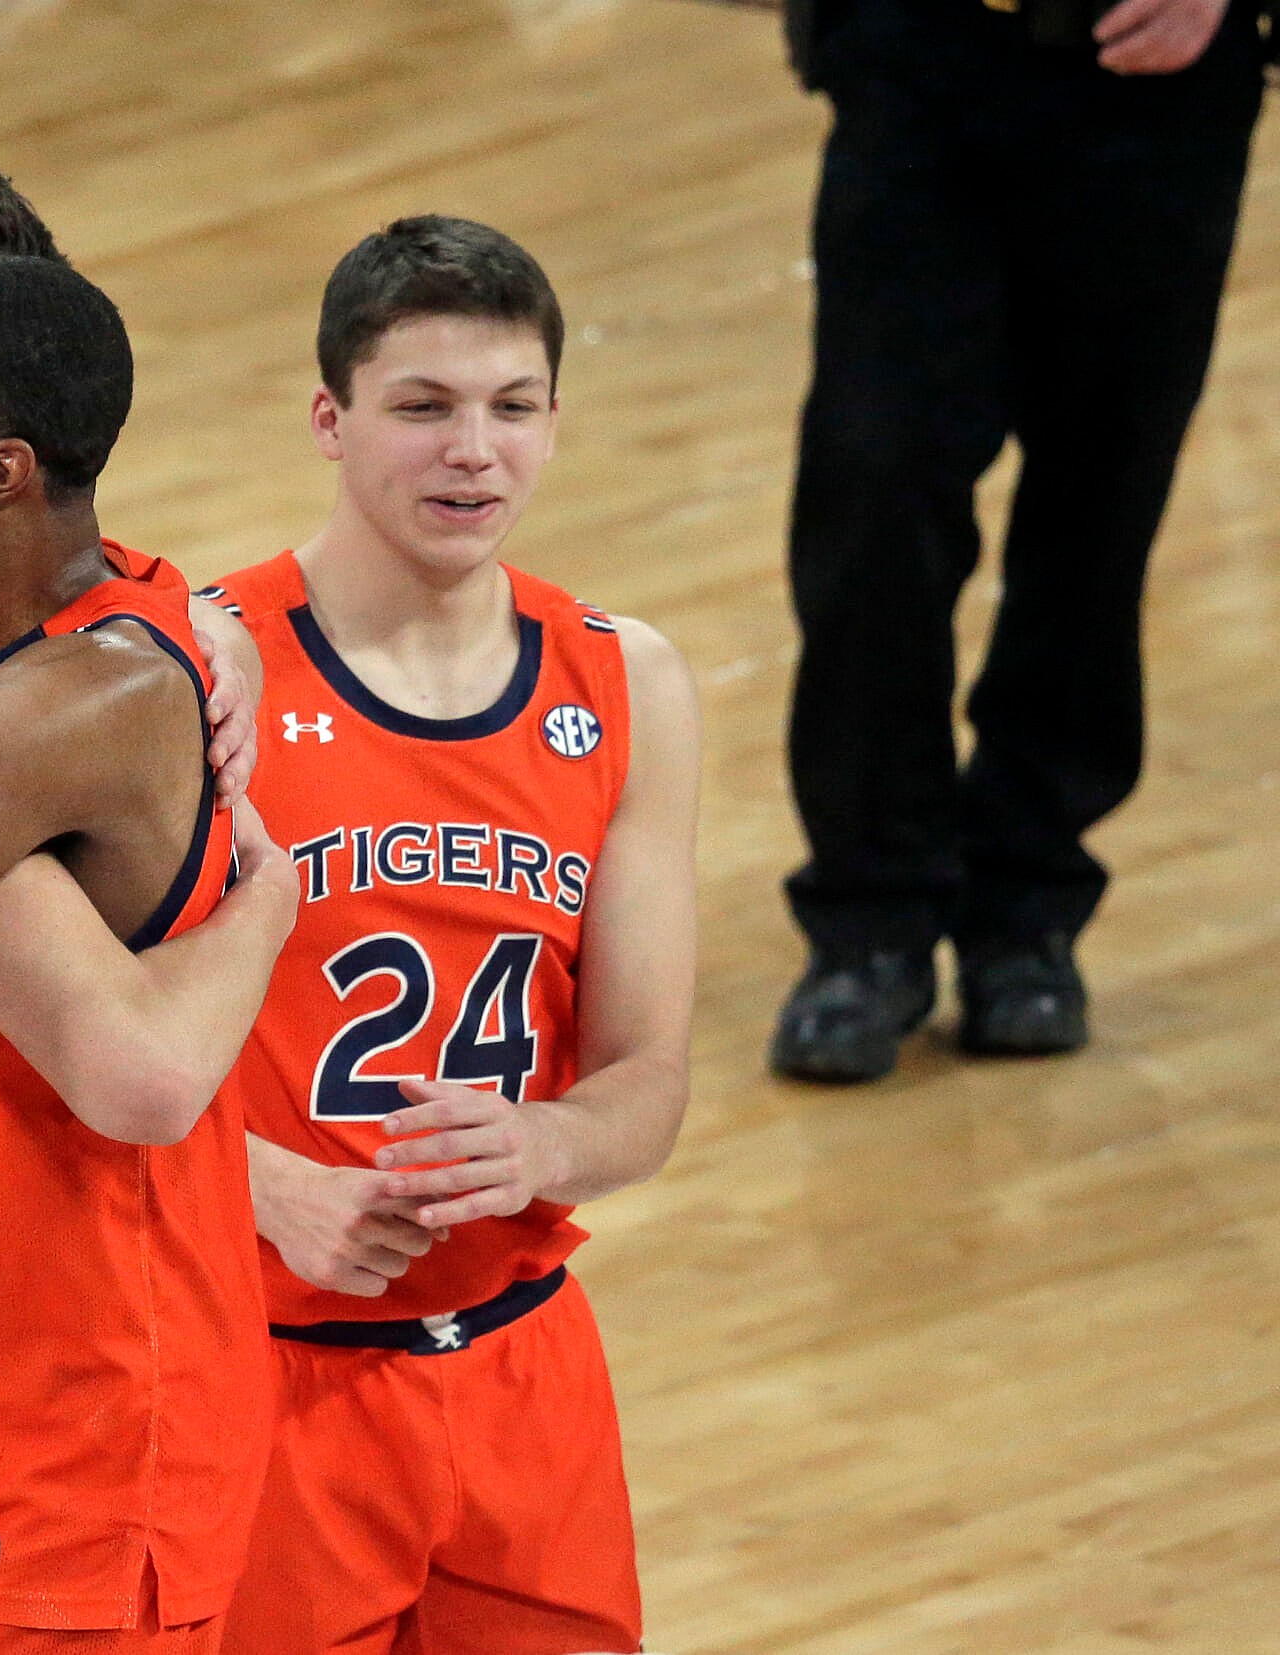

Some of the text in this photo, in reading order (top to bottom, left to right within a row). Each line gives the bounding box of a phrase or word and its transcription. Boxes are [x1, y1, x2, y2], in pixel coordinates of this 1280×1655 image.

[543, 705, 602, 757] SEC
[290, 822, 591, 917] TIGERS
[310, 931, 544, 1122] 24
